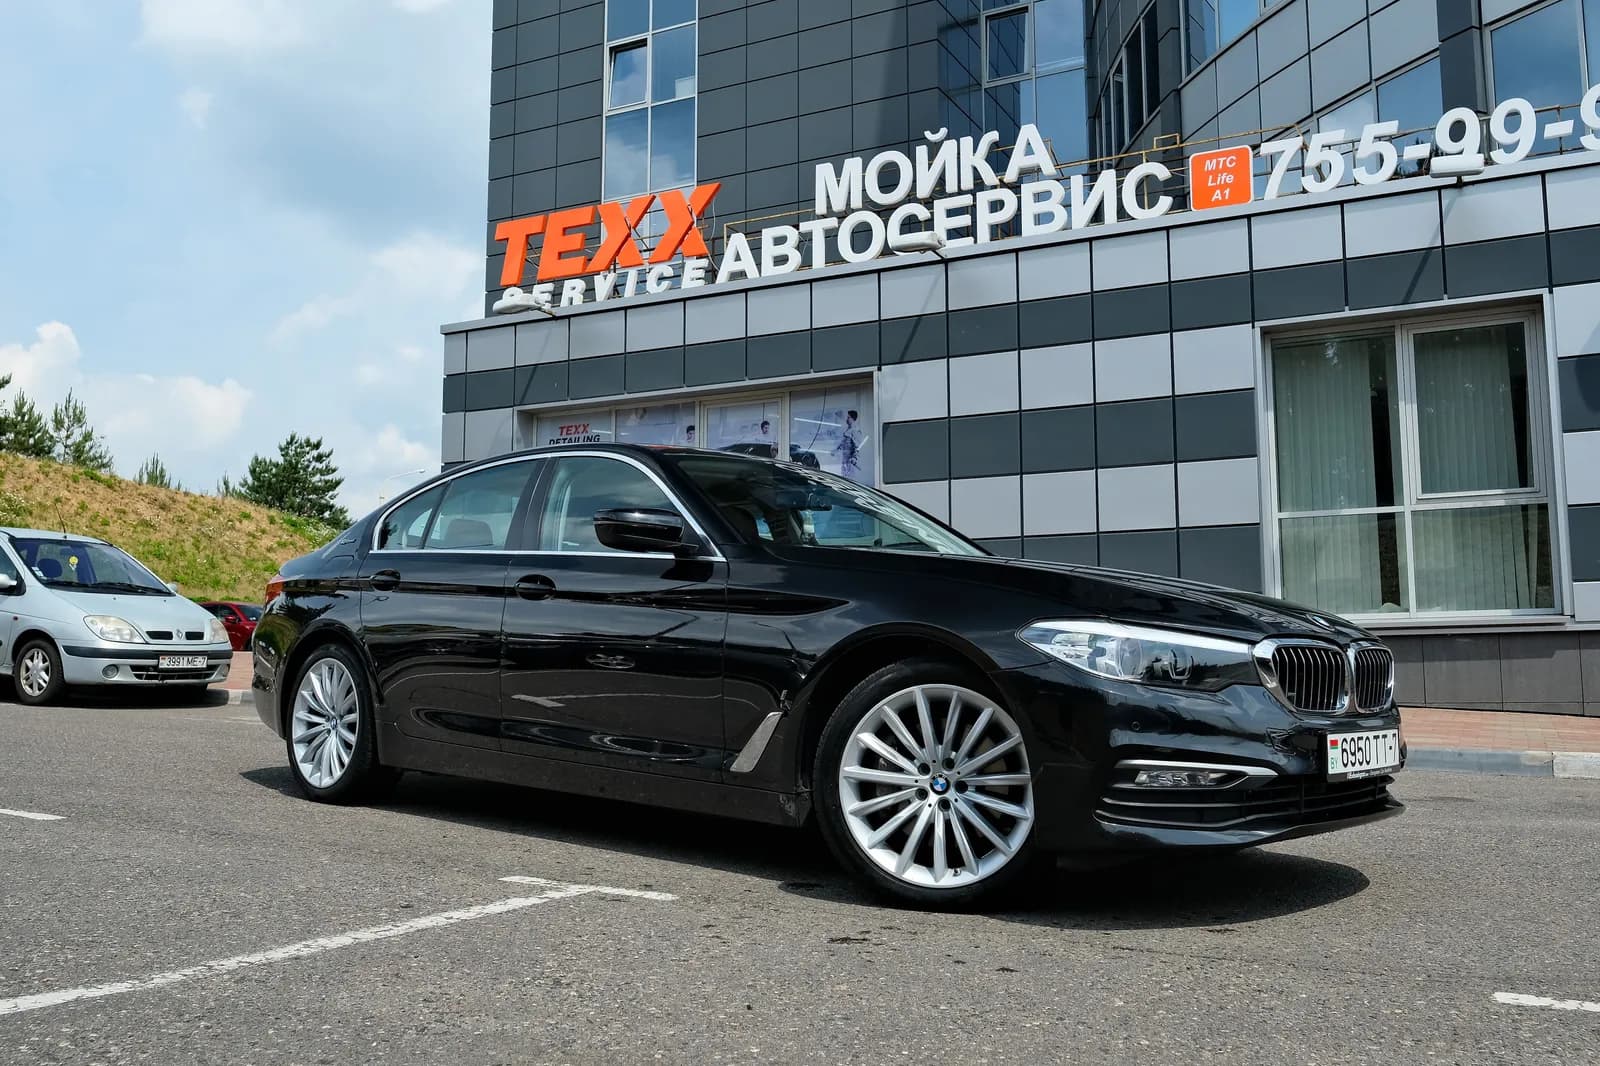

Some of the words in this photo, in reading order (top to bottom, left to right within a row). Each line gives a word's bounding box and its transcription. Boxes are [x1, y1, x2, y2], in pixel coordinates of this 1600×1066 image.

[815, 123, 1057, 216] МОЙКА
[1208, 172, 1234, 187] Life
[1211, 187, 1231, 202] A1
[495, 182, 721, 287] TEXX
[715, 162, 1174, 284] АВТОСЕРВИС
[559, 424, 590, 436] TEXX
[1341, 735, 1371, 768] 6950
